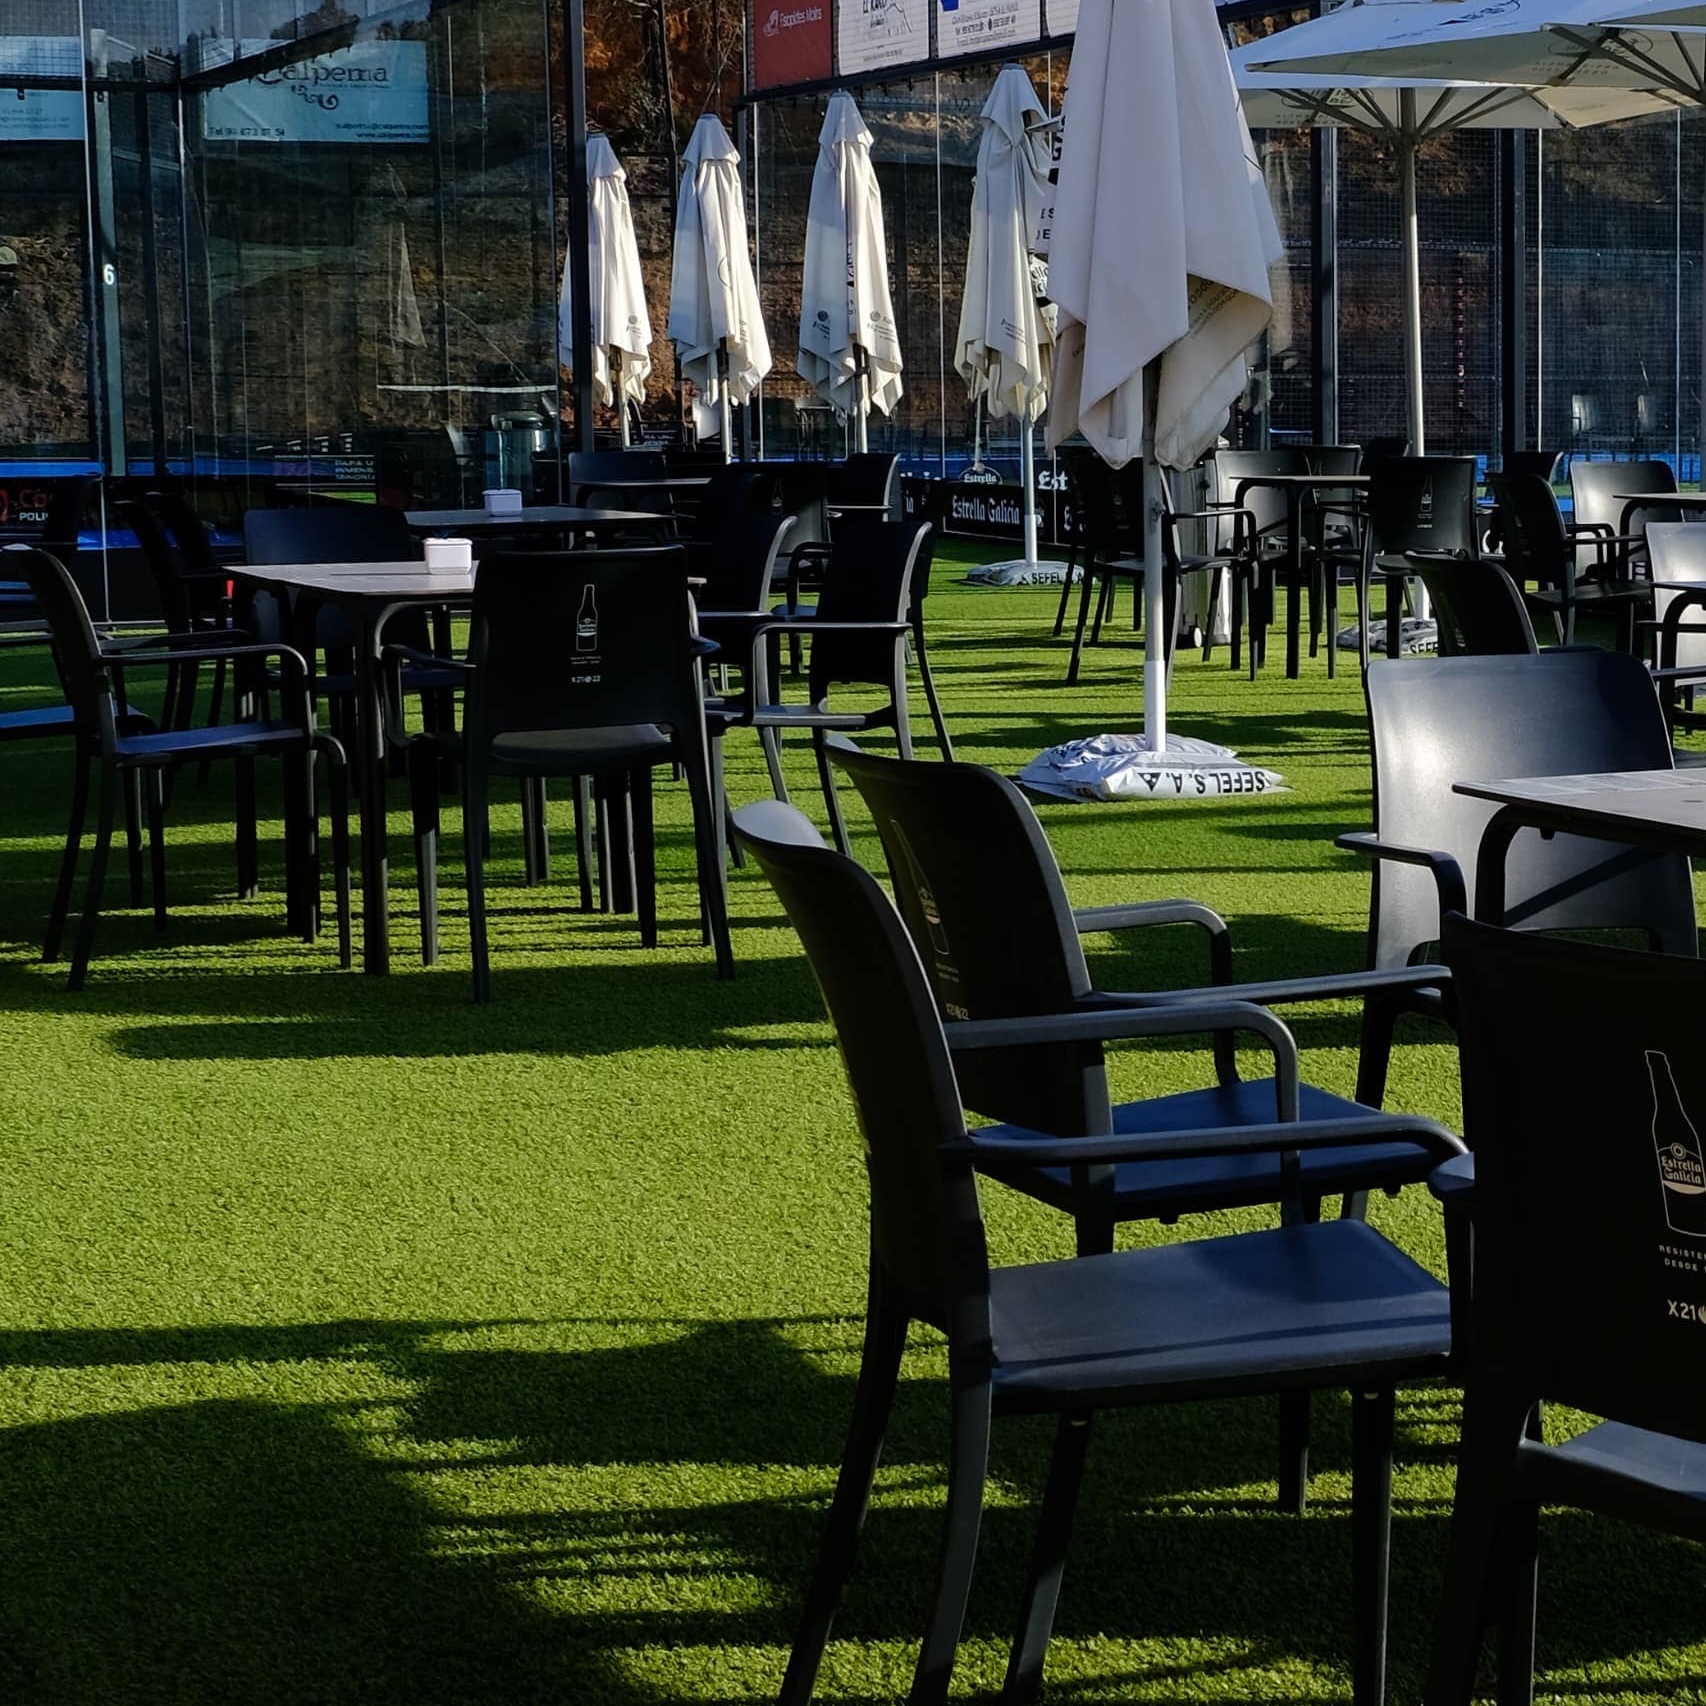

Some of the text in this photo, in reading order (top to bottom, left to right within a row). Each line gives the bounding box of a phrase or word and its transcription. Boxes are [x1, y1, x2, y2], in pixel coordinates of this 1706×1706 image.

[103, 264, 115, 286] 6
[963, 472, 998, 484] Estrella
[952, 494, 1020, 525] Estrella Galicia
[1031, 572, 1060, 585] SEFEL
[1410, 640, 1439, 655] SEFE
[1208, 771, 1266, 794] SEFEL
[1661, 1155, 1702, 1174] Estrella
[1664, 1166, 1702, 1185] Galicia
[1664, 1257, 1699, 1273] DESDE
